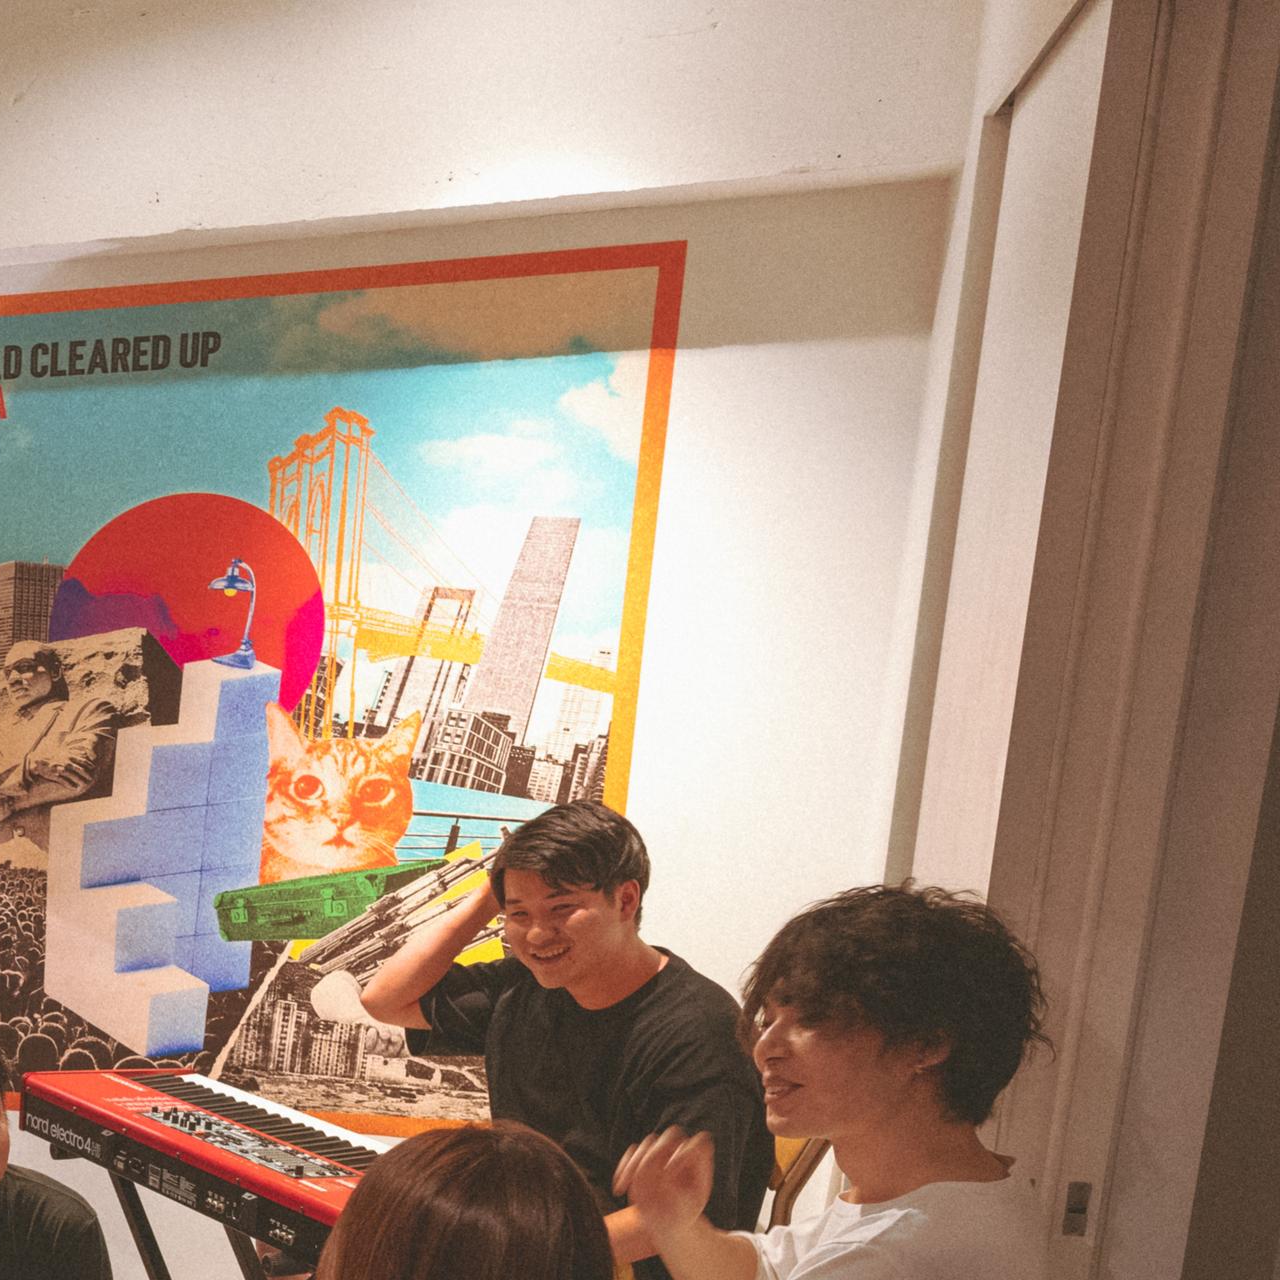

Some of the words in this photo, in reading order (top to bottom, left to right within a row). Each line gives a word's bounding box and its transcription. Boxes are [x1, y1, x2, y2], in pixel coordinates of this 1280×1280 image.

[29, 333, 172, 379] CLEARED
[179, 330, 222, 369] UP
[25, 1112, 49, 1134] nord
